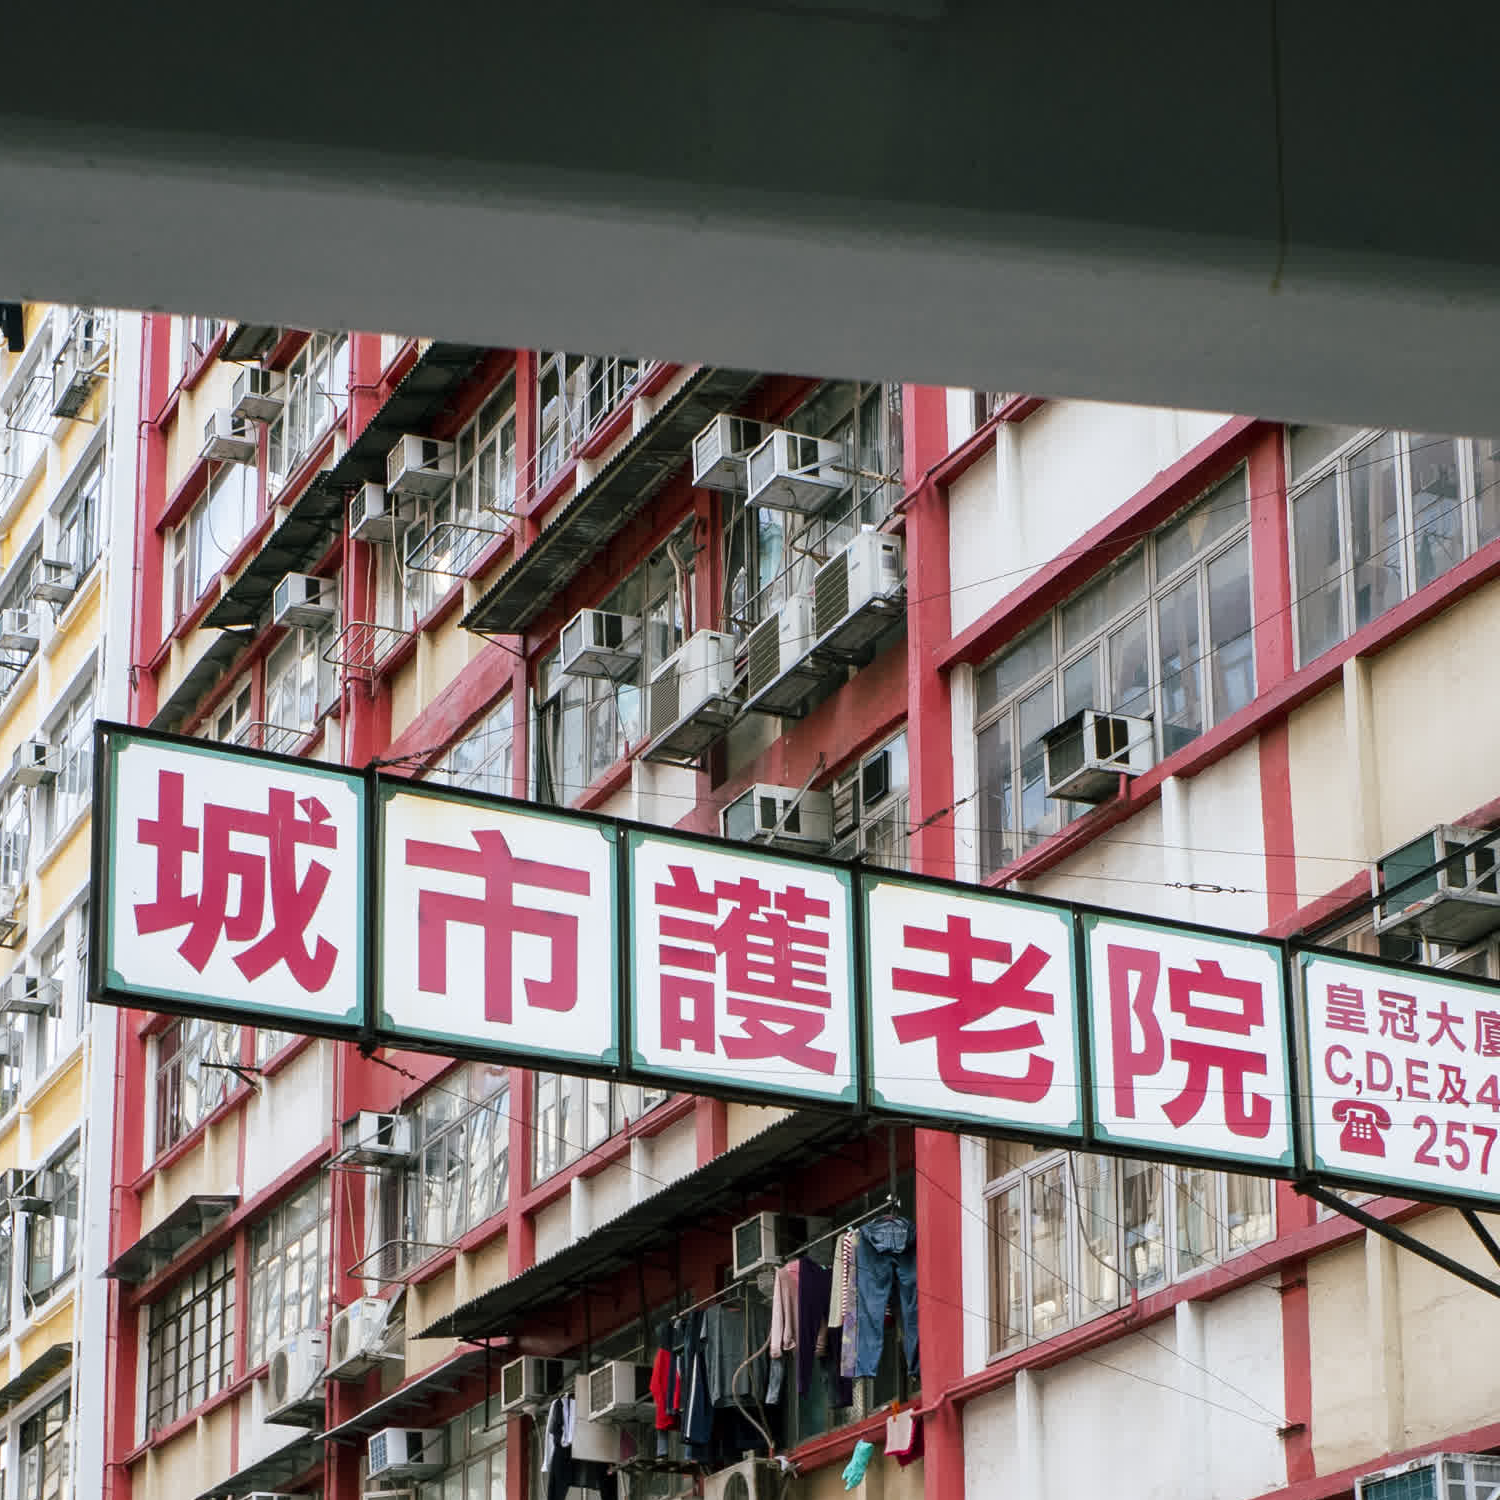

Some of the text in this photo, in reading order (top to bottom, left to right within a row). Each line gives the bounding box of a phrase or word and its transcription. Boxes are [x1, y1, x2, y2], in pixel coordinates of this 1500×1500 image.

[134, 769, 1271, 1139] 城市護老院
